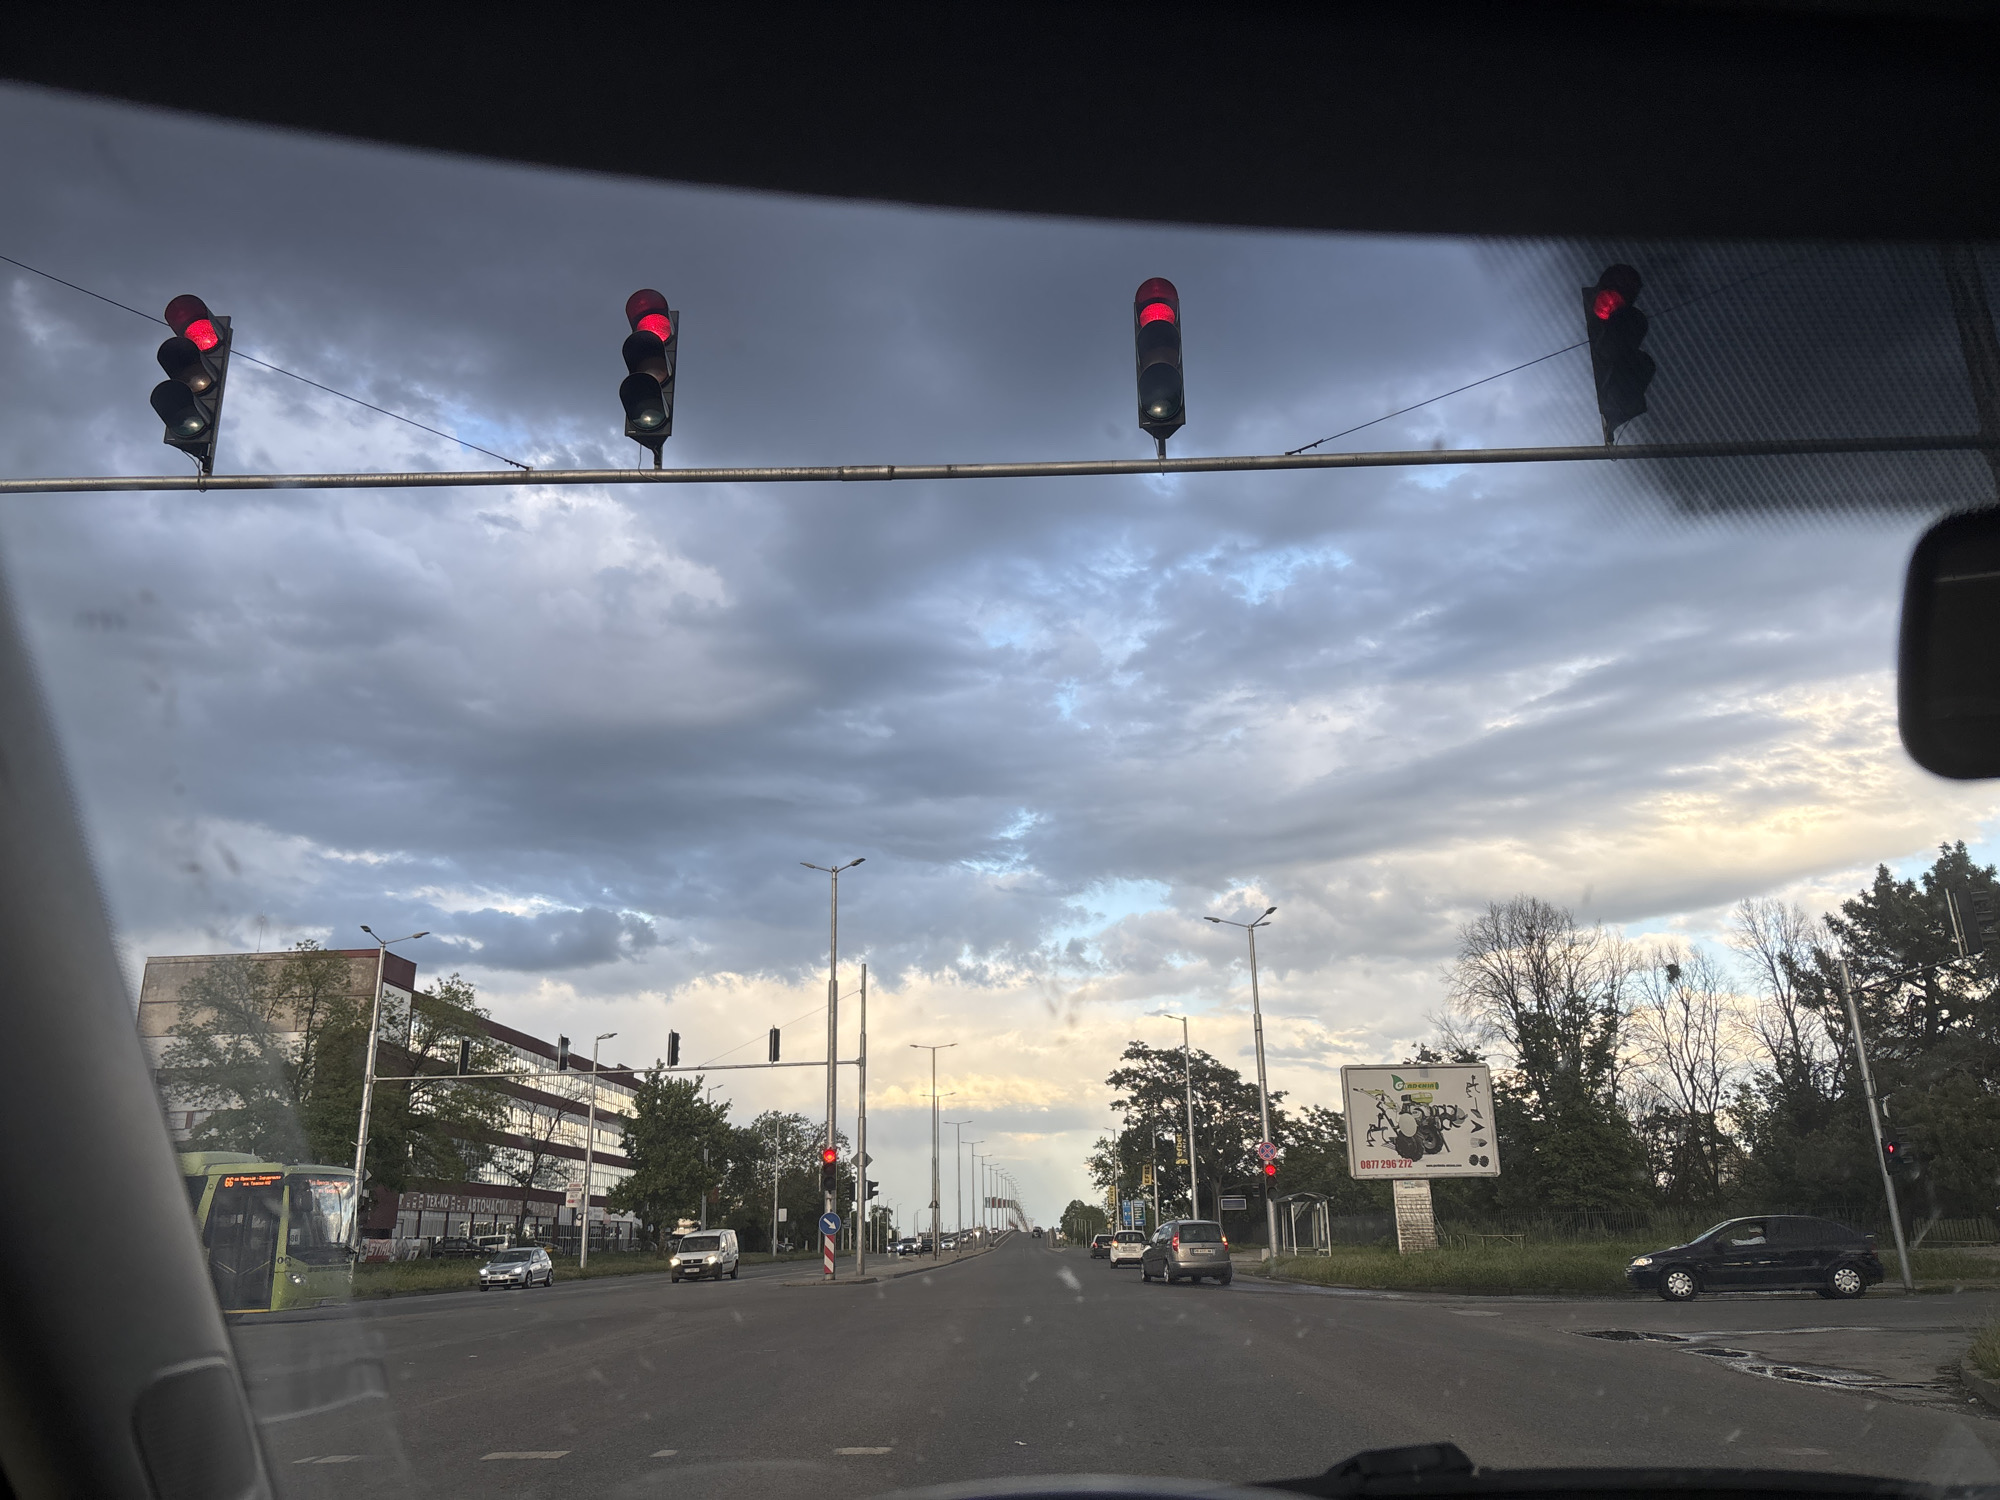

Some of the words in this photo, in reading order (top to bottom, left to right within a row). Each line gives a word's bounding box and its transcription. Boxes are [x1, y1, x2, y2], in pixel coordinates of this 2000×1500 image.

[1360, 1160, 1380, 1169] 0877
[1380, 1159, 1397, 1169] 296
[1398, 1159, 1413, 1168] 272
[426, 1194, 449, 1208] ТЕХ-КО
[467, 1198, 509, 1214] АВТОЧАСТИ
